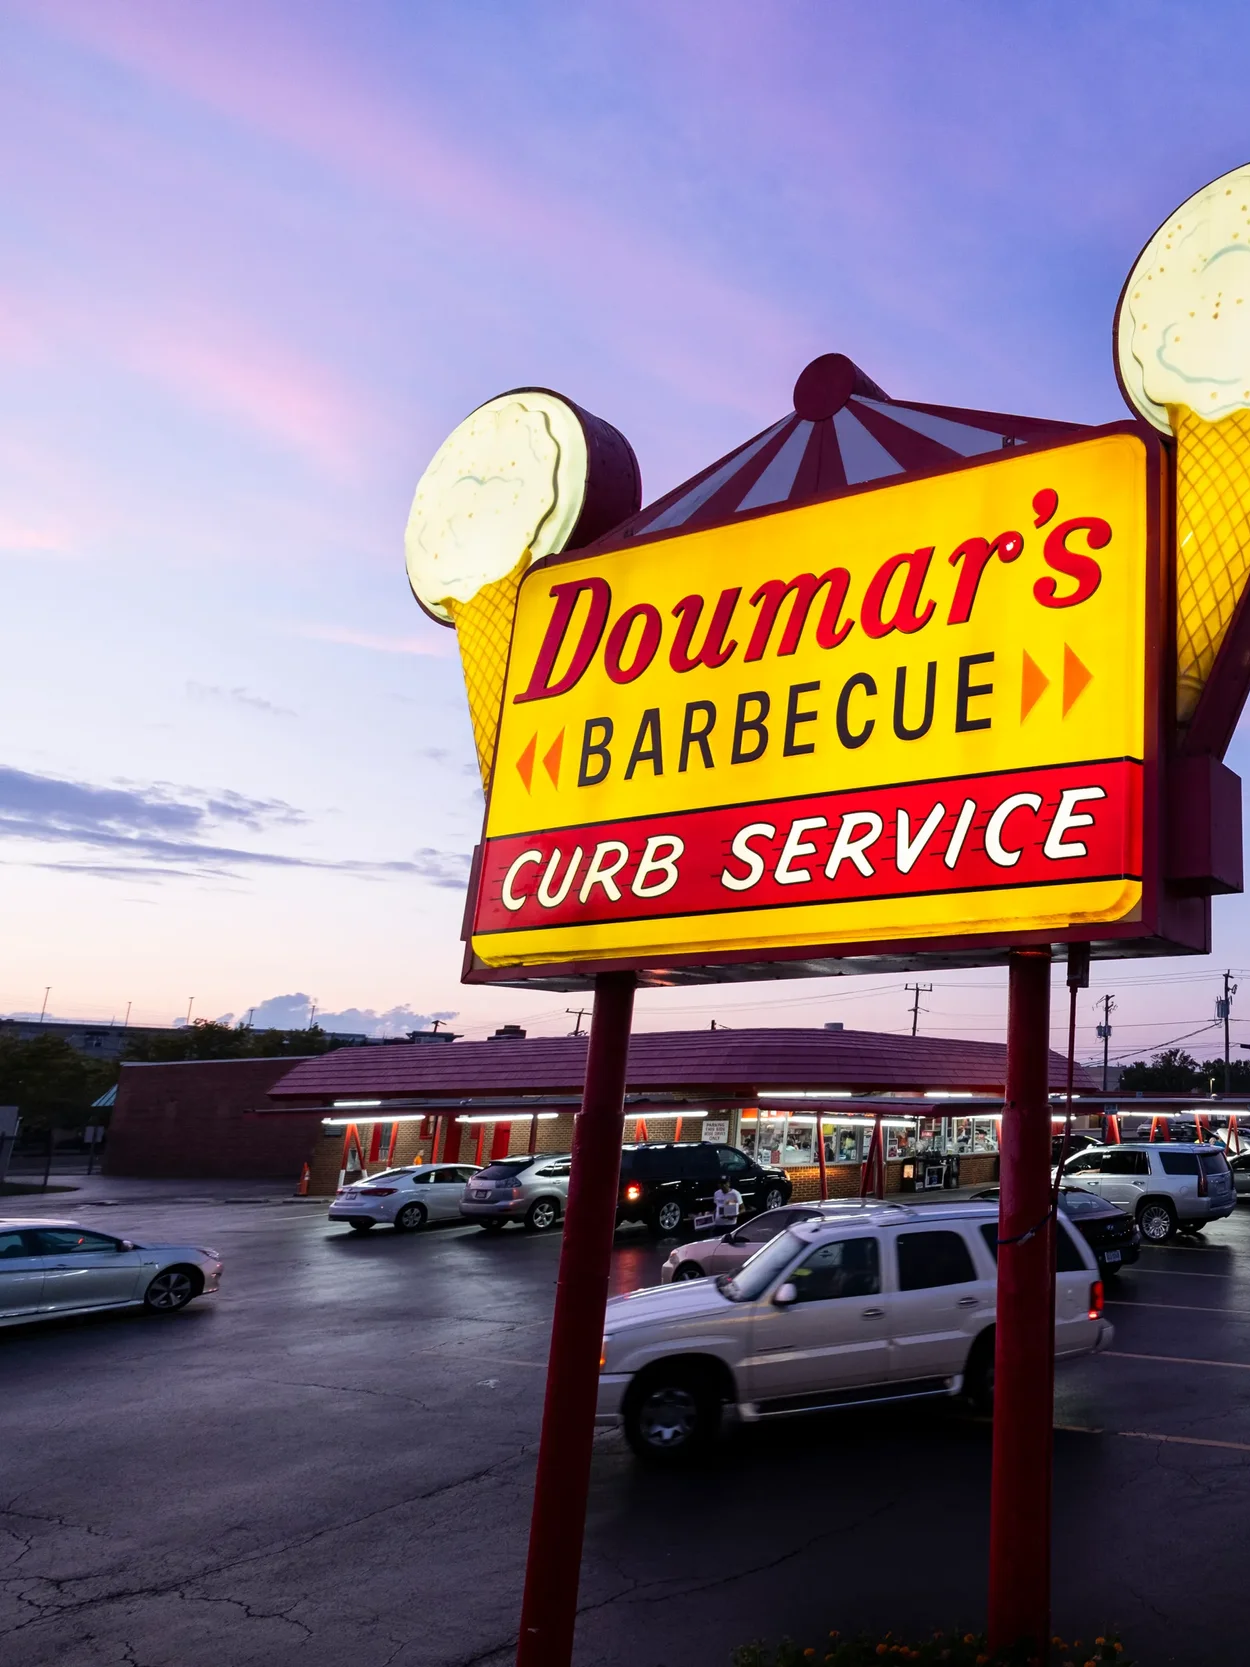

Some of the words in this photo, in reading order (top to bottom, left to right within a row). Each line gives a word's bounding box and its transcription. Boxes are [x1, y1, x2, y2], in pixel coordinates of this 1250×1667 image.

[513, 487, 1112, 704] Doumar's
[576, 651, 996, 787] BARBECUE
[501, 834, 685, 911] CURB
[720, 786, 1106, 892] SERVICE
